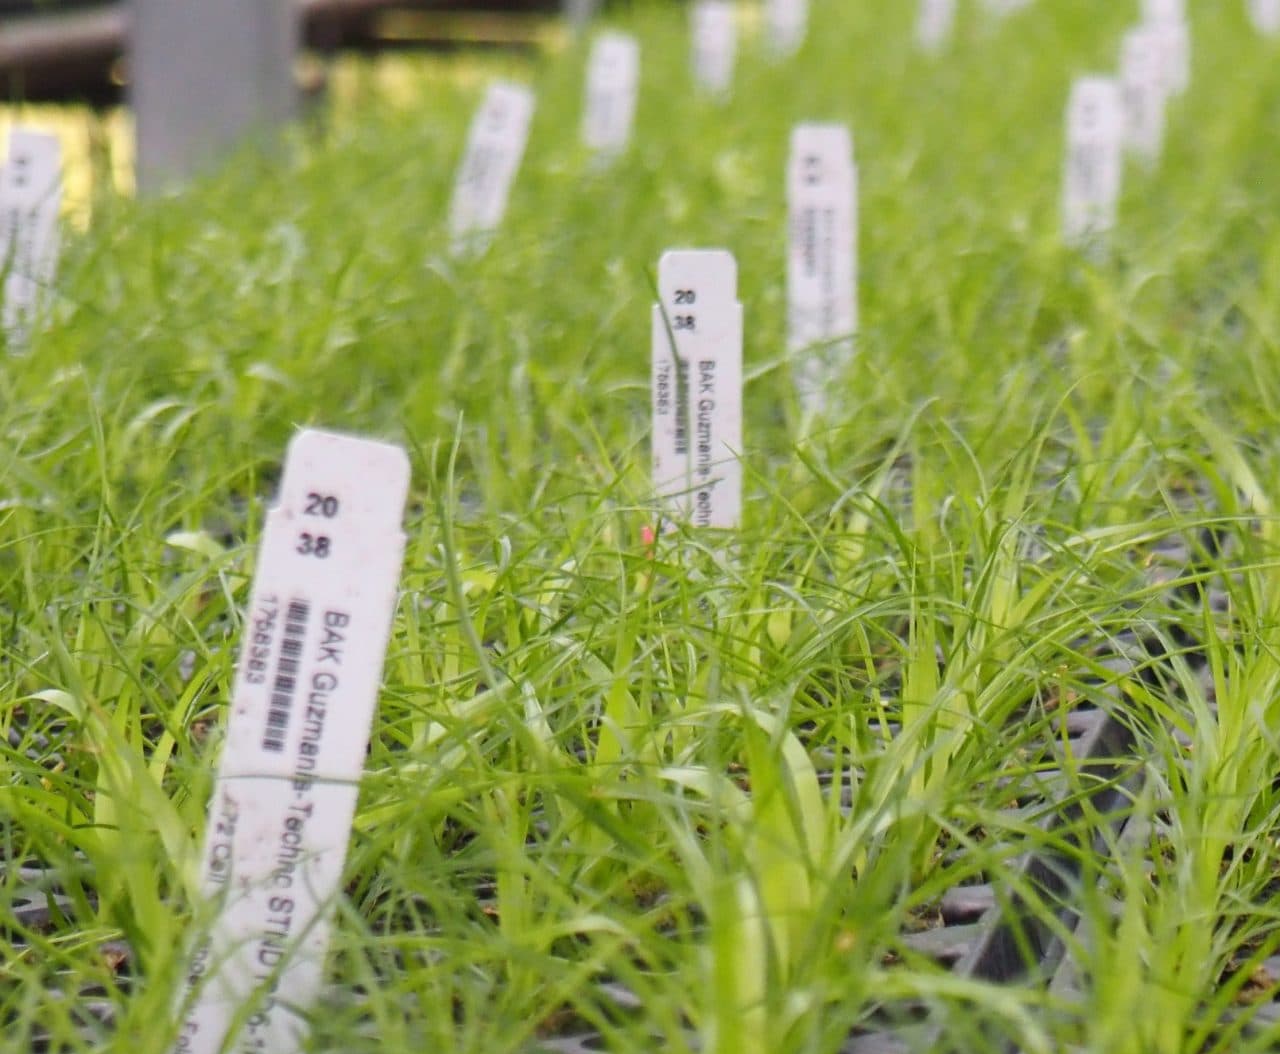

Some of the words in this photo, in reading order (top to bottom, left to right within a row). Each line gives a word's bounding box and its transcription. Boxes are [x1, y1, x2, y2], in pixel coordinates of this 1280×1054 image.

[674, 289, 696, 305] 20
[673, 315, 696, 331] 38
[699, 360, 716, 394] BAK
[303, 492, 340, 519] 20
[295, 531, 332, 560] 38
[315, 609, 351, 666] BAK
